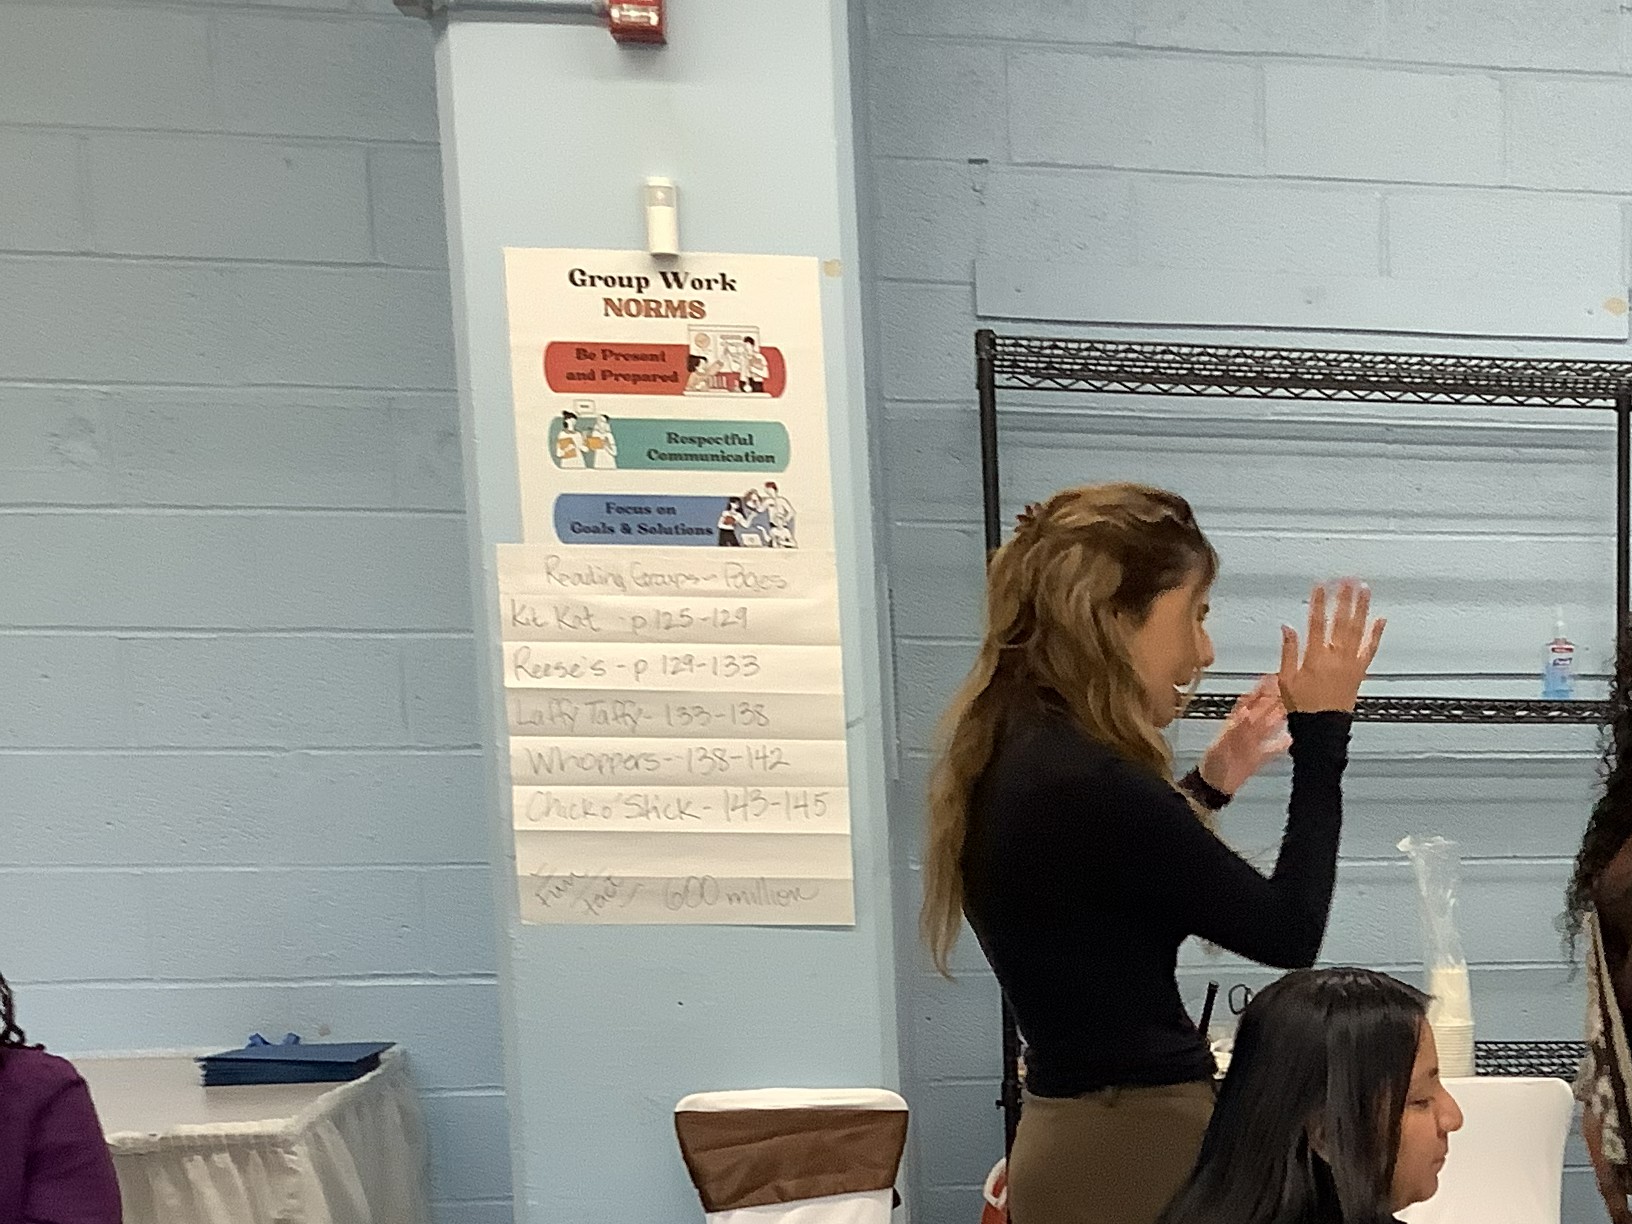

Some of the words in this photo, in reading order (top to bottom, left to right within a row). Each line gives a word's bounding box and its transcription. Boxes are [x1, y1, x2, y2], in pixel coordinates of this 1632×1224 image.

[569, 267, 649, 294] Group
[659, 271, 737, 292] Work
[603, 297, 707, 320] NORMS
[575, 348, 596, 361] Be
[601, 348, 666, 364] Present
[565, 369, 596, 382] and
[601, 369, 679, 385] Prepared
[666, 431, 754, 448] Respectful
[647, 449, 776, 465] Communication
[605, 502, 651, 515] Focus
[656, 504, 677, 515] on
[570, 521, 616, 536] Goals
[621, 522, 633, 535] &
[637, 522, 714, 537] Solutions
[545, 554, 625, 592] Reading
[511, 599, 546, 627] Kit
[554, 605, 600, 632] Kat
